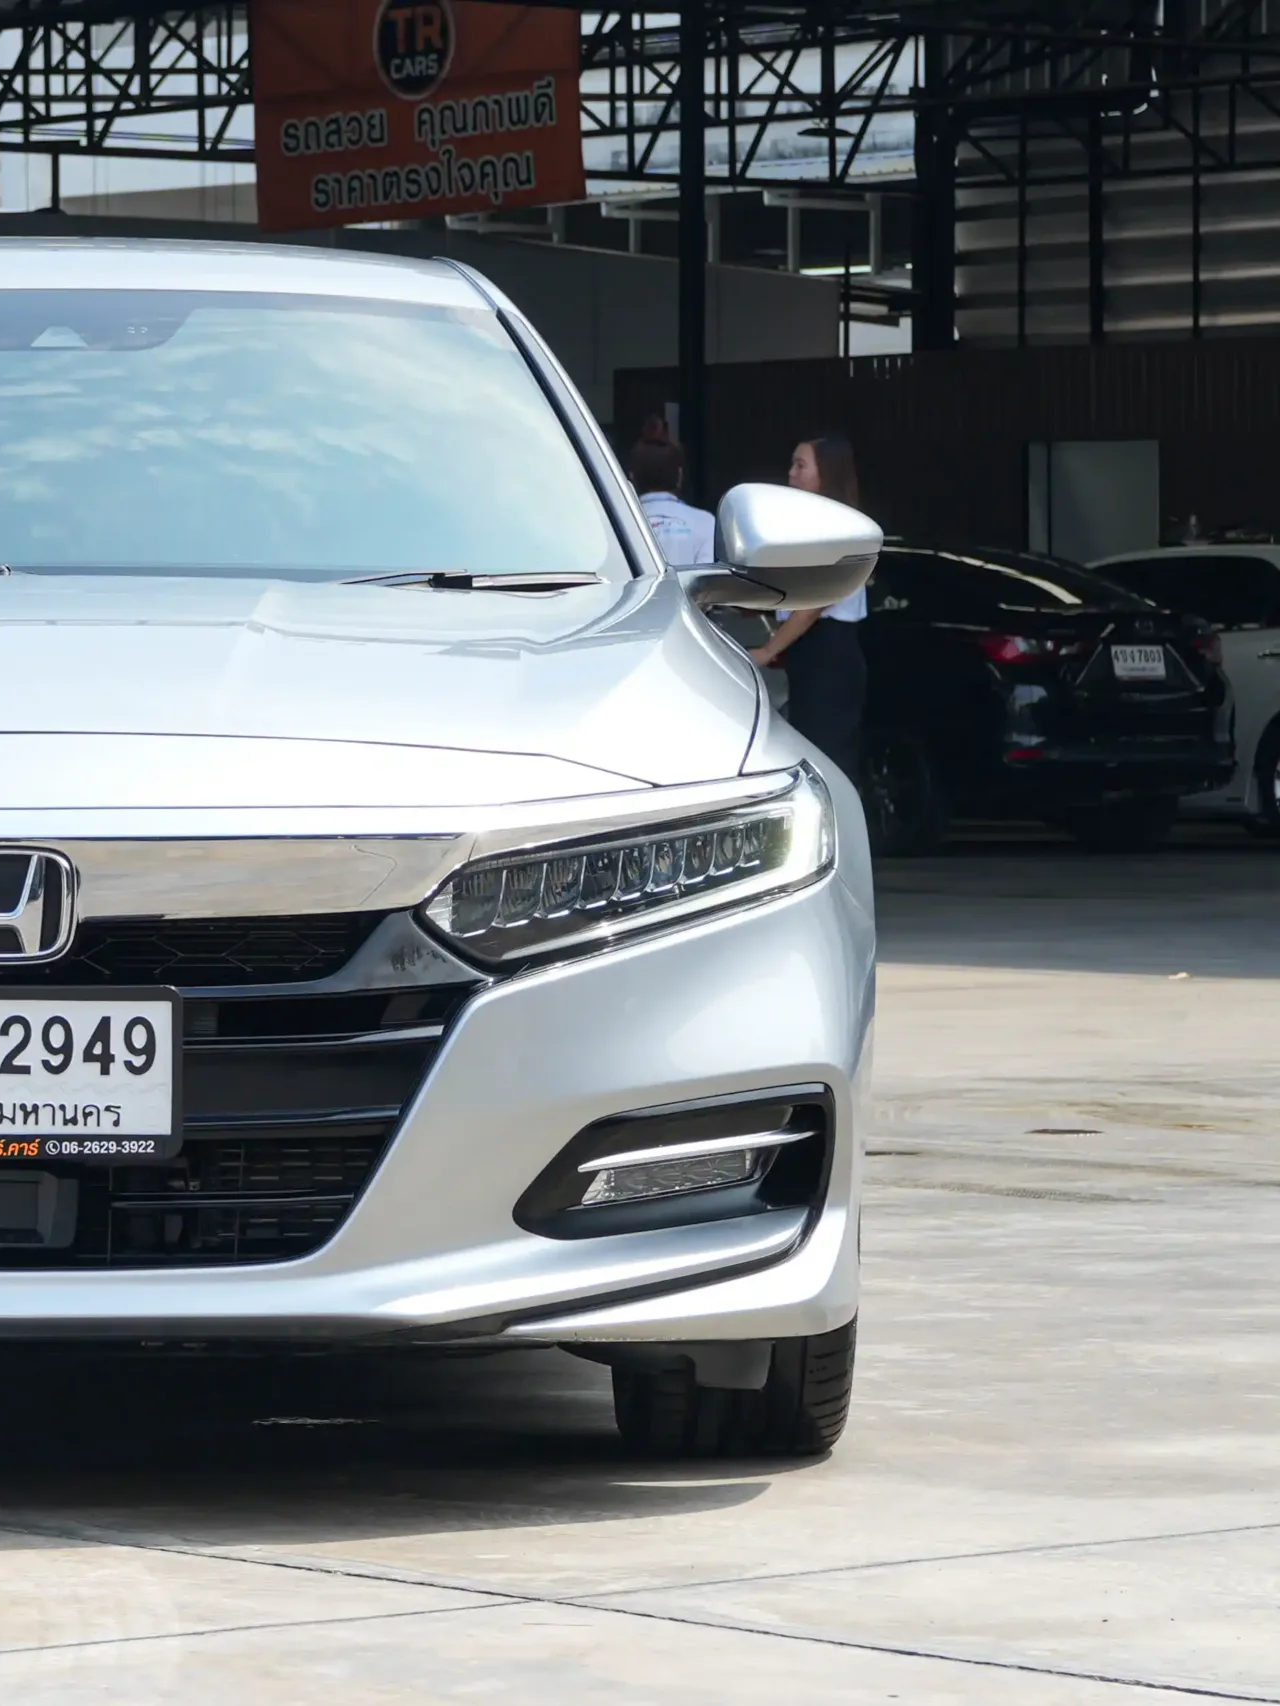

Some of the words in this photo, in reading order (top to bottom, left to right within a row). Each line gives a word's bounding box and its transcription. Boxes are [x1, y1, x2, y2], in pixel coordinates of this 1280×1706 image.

[387, 5, 443, 54] TR
[389, 53, 439, 79] CARS
[282, 109, 387, 155] รถสวย
[415, 76, 556, 149] คุณภาพดี
[313, 148, 535, 212] ราคาตรงใจคุณ
[61, 1140, 155, 1154] 06-2629-3922
